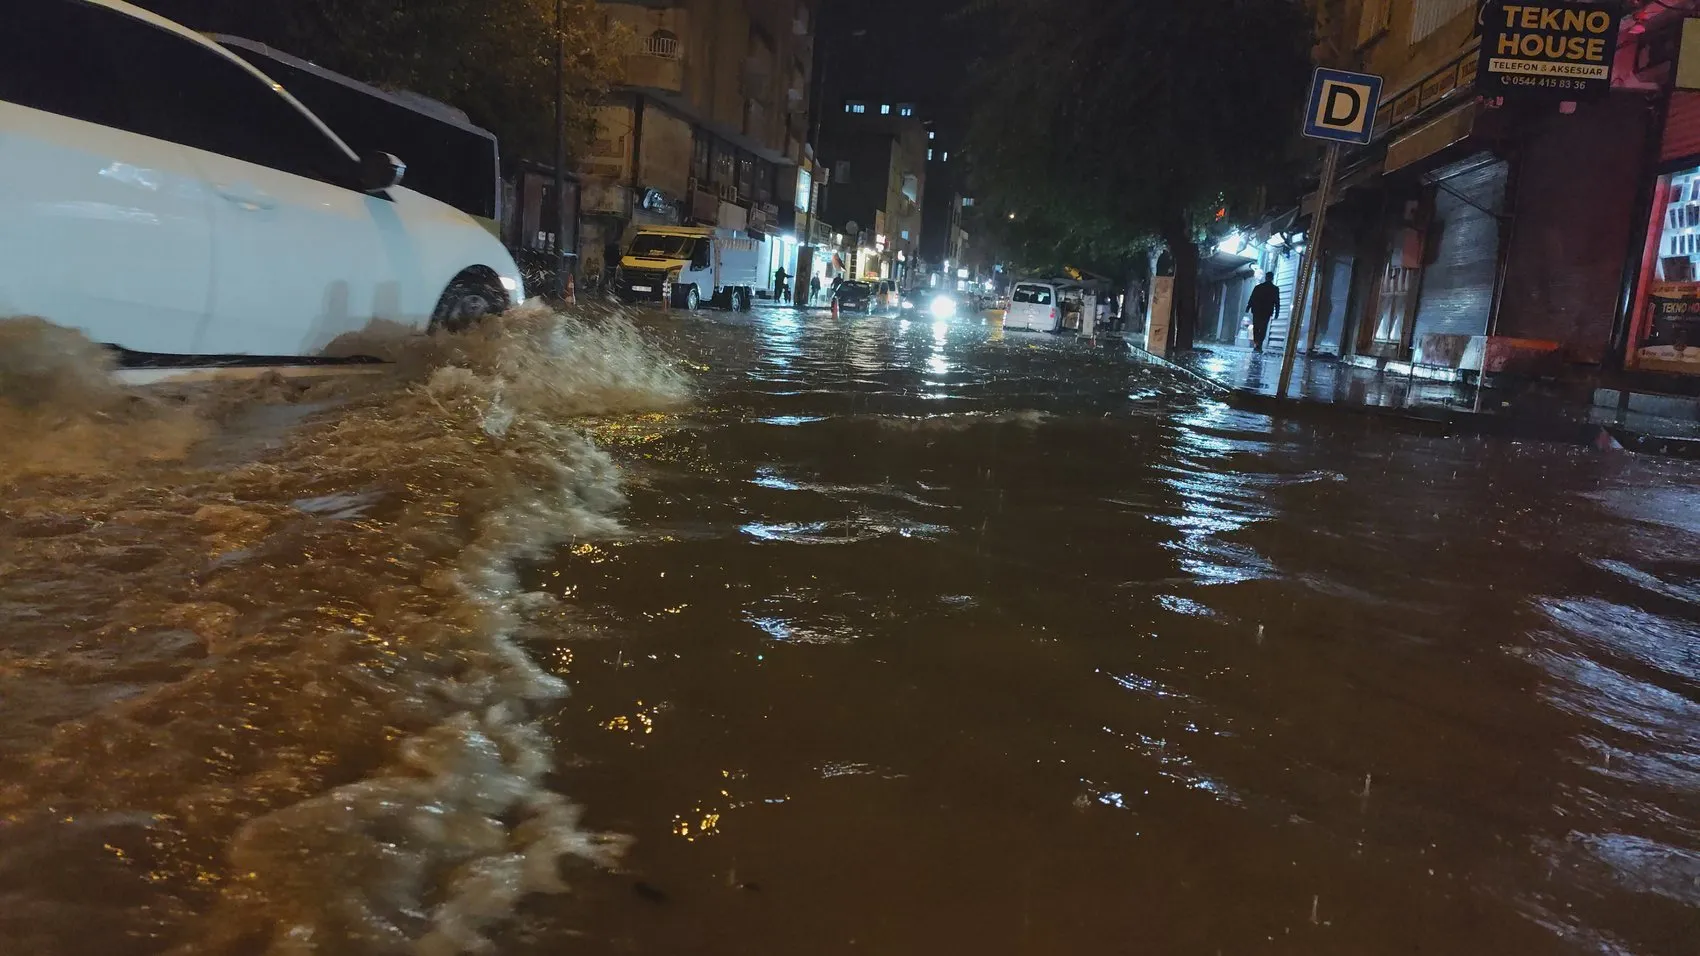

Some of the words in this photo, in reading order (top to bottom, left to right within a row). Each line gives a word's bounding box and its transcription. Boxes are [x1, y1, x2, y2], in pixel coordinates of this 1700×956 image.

[1502, 5, 1610, 34] TEKNO
[1497, 32, 1606, 61] HOUSE
[1493, 61, 1538, 71] TELEFON
[1540, 63, 1548, 72] &
[1550, 65, 1603, 76] AKSESUAR
[1512, 76, 1536, 86] 0544
[1539, 78, 1557, 88] 415
[1559, 79, 1571, 89] 83
[1574, 80, 1586, 90] 36
[1322, 83, 1361, 126] D
[1662, 302, 1688, 313] TEKNO
